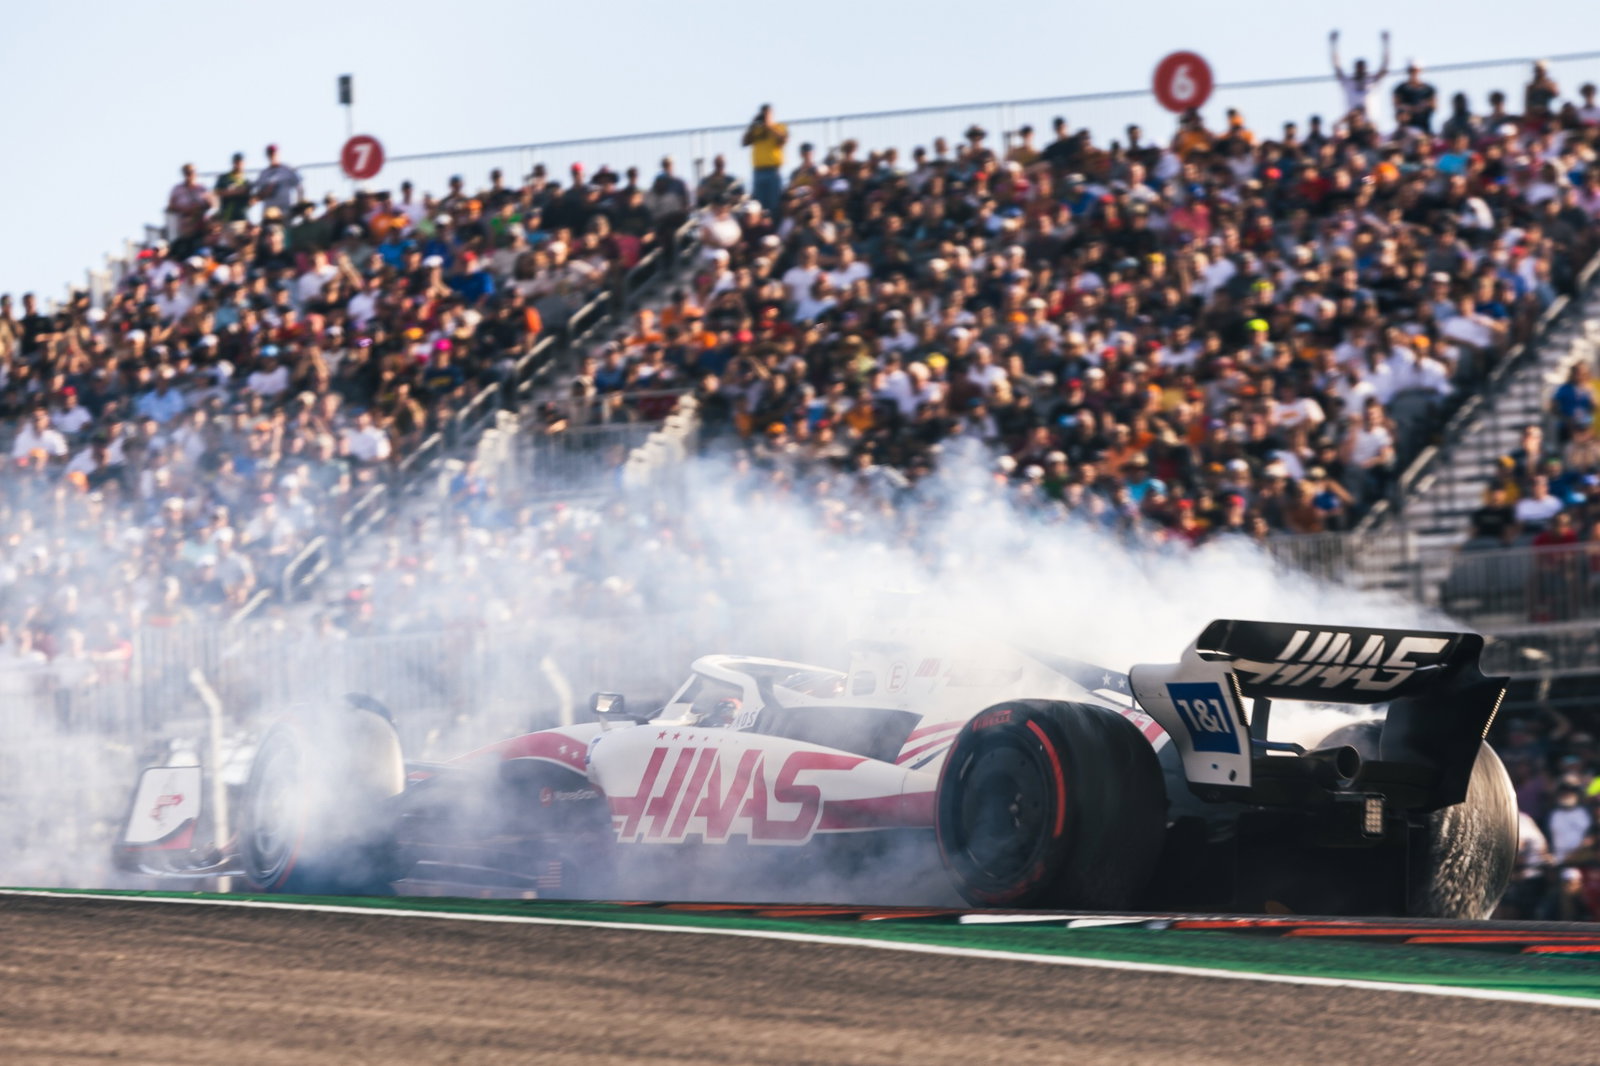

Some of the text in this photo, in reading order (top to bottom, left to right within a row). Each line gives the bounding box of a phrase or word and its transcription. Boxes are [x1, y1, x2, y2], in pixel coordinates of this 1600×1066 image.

[1170, 63, 1198, 101] 6
[351, 142, 374, 172] 7
[889, 664, 904, 690] E
[1232, 629, 1450, 692] HAAS
[1176, 698, 1231, 734] 1&1
[607, 747, 868, 841] HAAS
